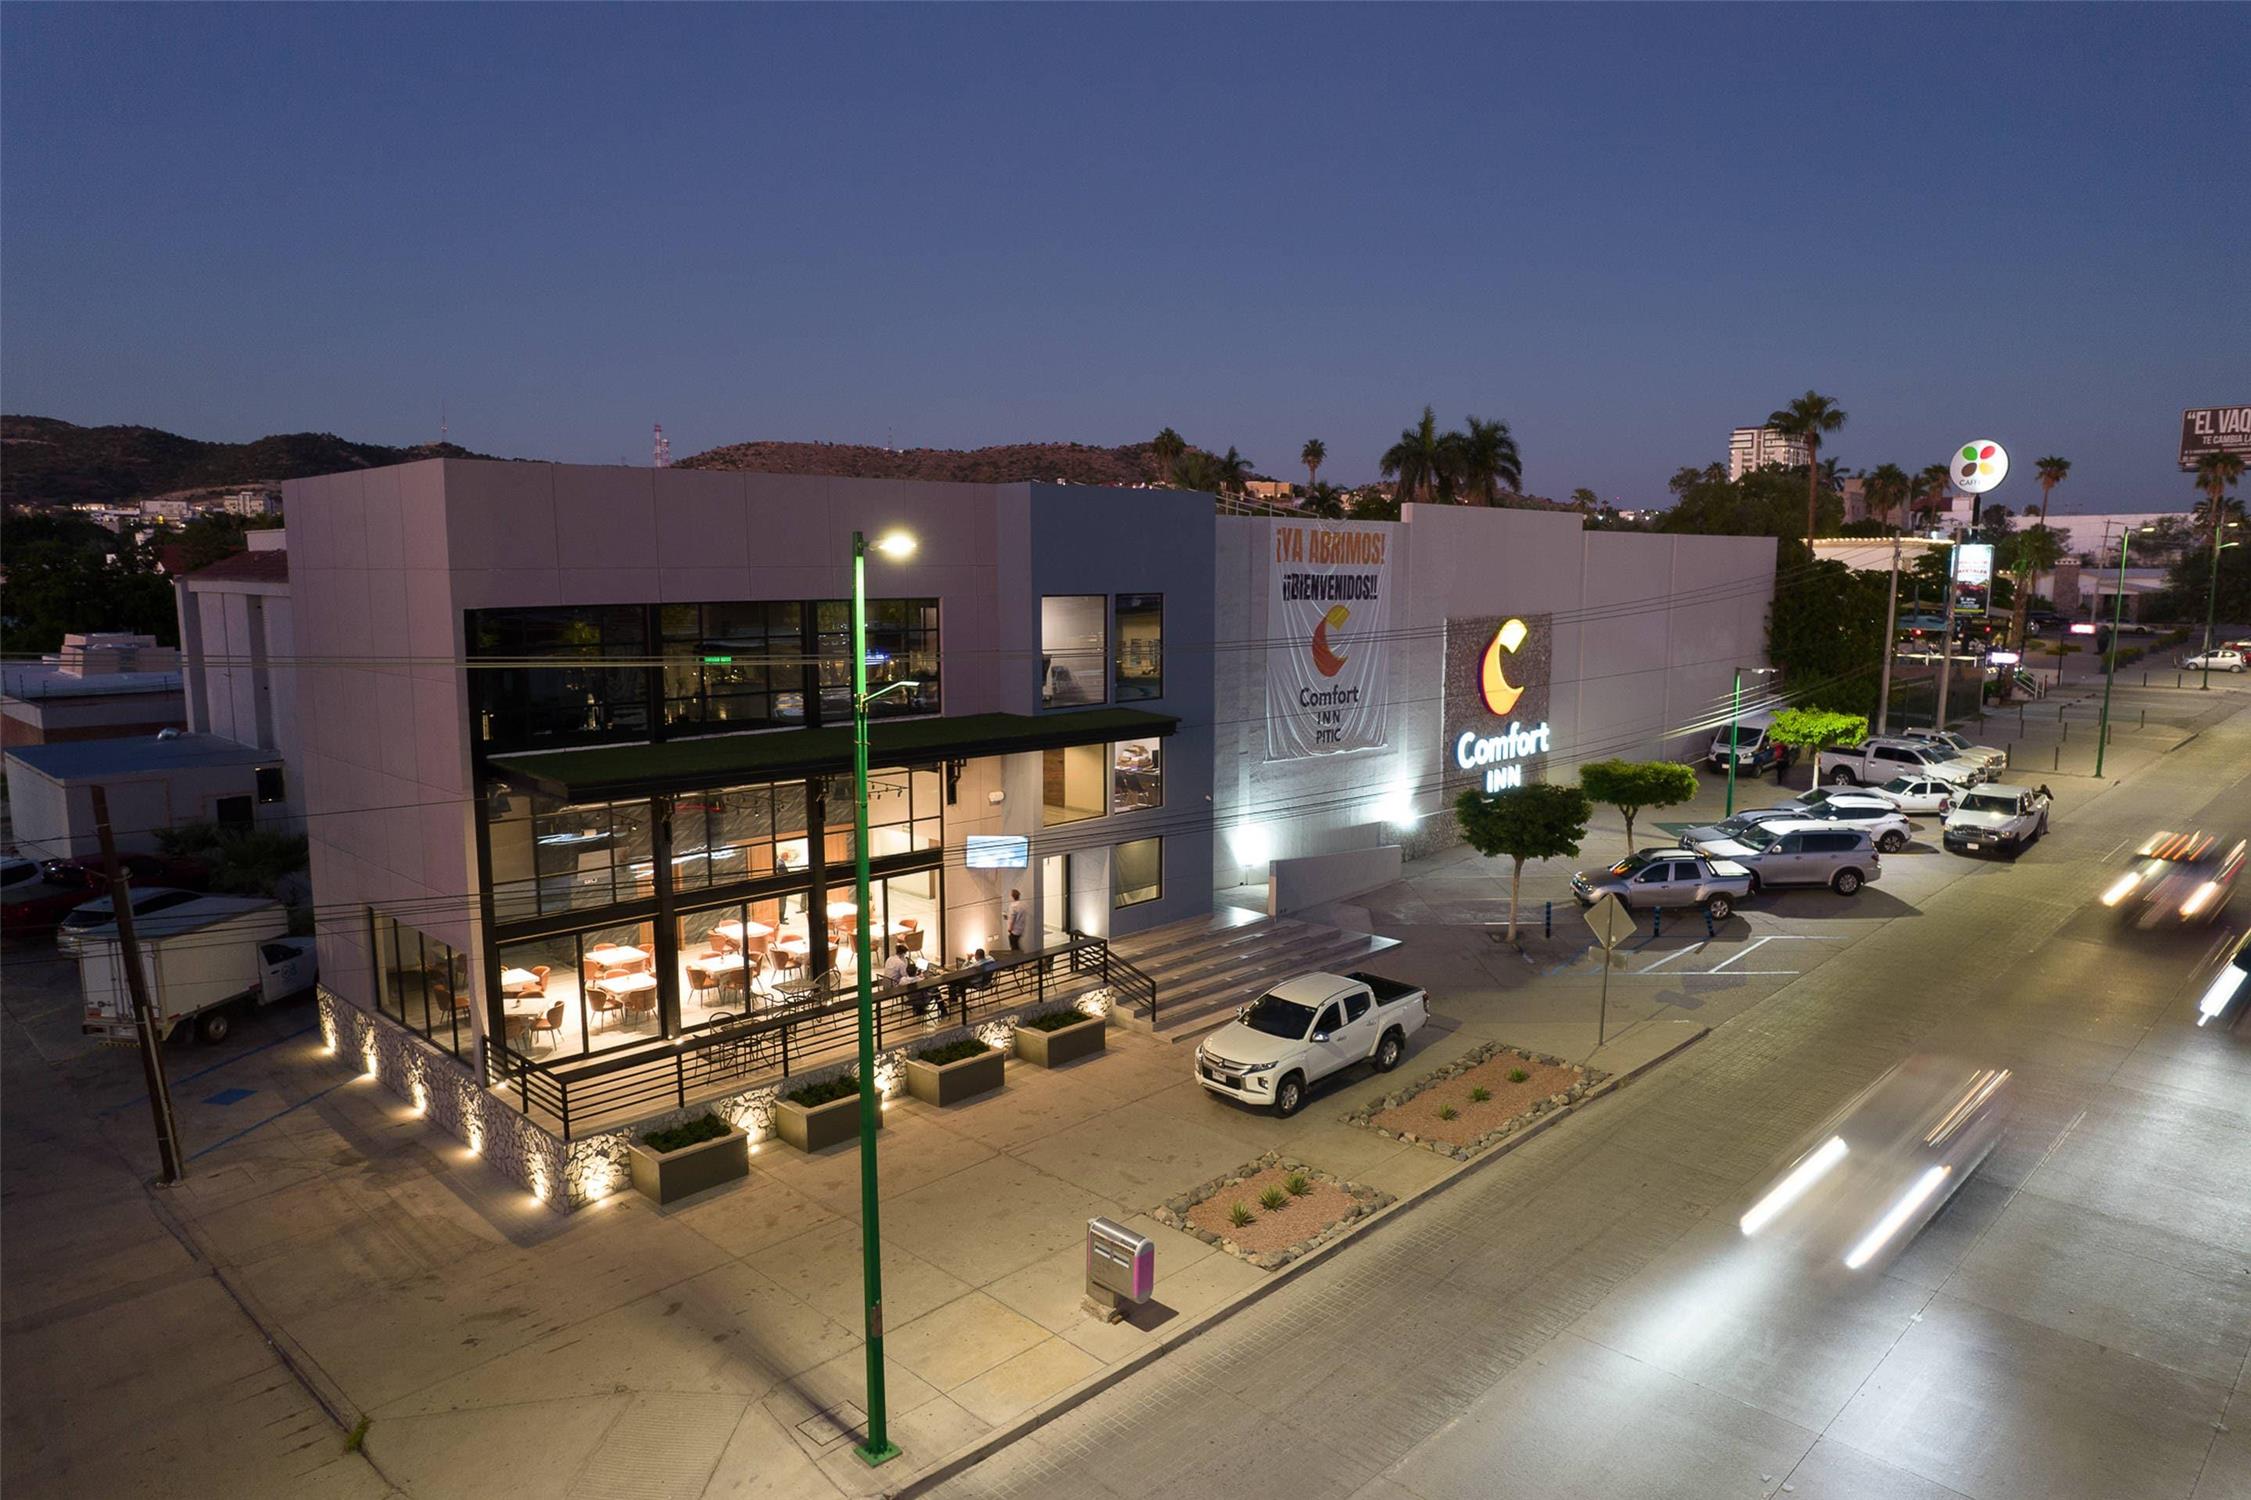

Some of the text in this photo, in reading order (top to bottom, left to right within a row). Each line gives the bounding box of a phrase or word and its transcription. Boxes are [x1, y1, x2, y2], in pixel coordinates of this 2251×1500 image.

[1276, 527, 1386, 565] ¡YA ABRIMOS!
[1300, 684, 1359, 707] Comfort
[1317, 710, 1341, 724] INN
[1316, 728, 1341, 744] PITIC
[1456, 721, 1550, 769] Comfort
[1486, 764, 1521, 793] INN
